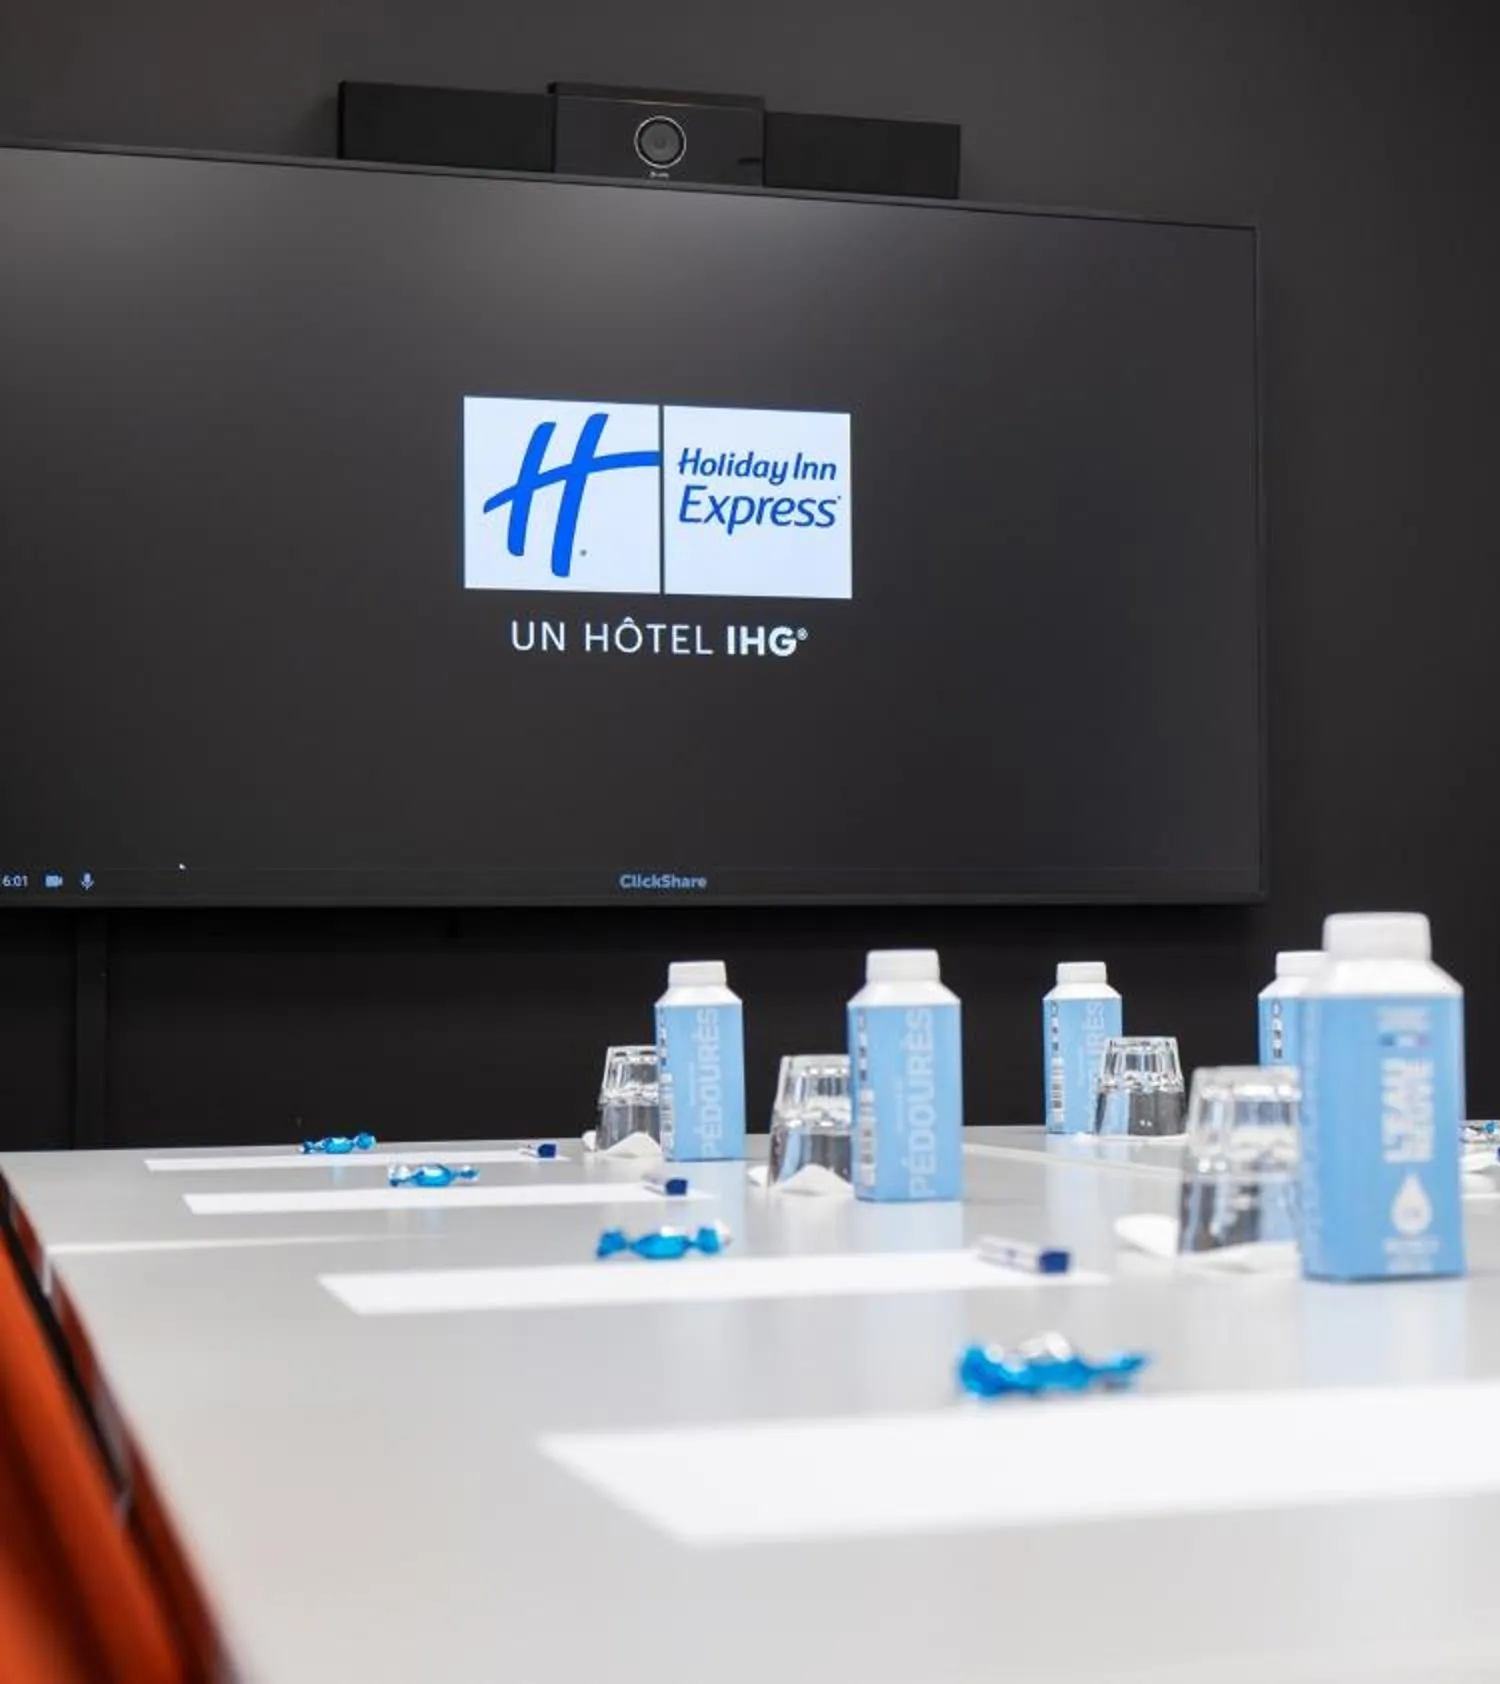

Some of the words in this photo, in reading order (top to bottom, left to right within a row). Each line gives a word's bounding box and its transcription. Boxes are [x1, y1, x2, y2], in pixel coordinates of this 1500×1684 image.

[678, 447, 790, 485] Holiday
[793, 452, 837, 481] Inn
[679, 485, 838, 535] Express
[511, 620, 565, 652] UN
[585, 617, 714, 655] HÔTEL
[619, 874, 708, 889] ClickShare
